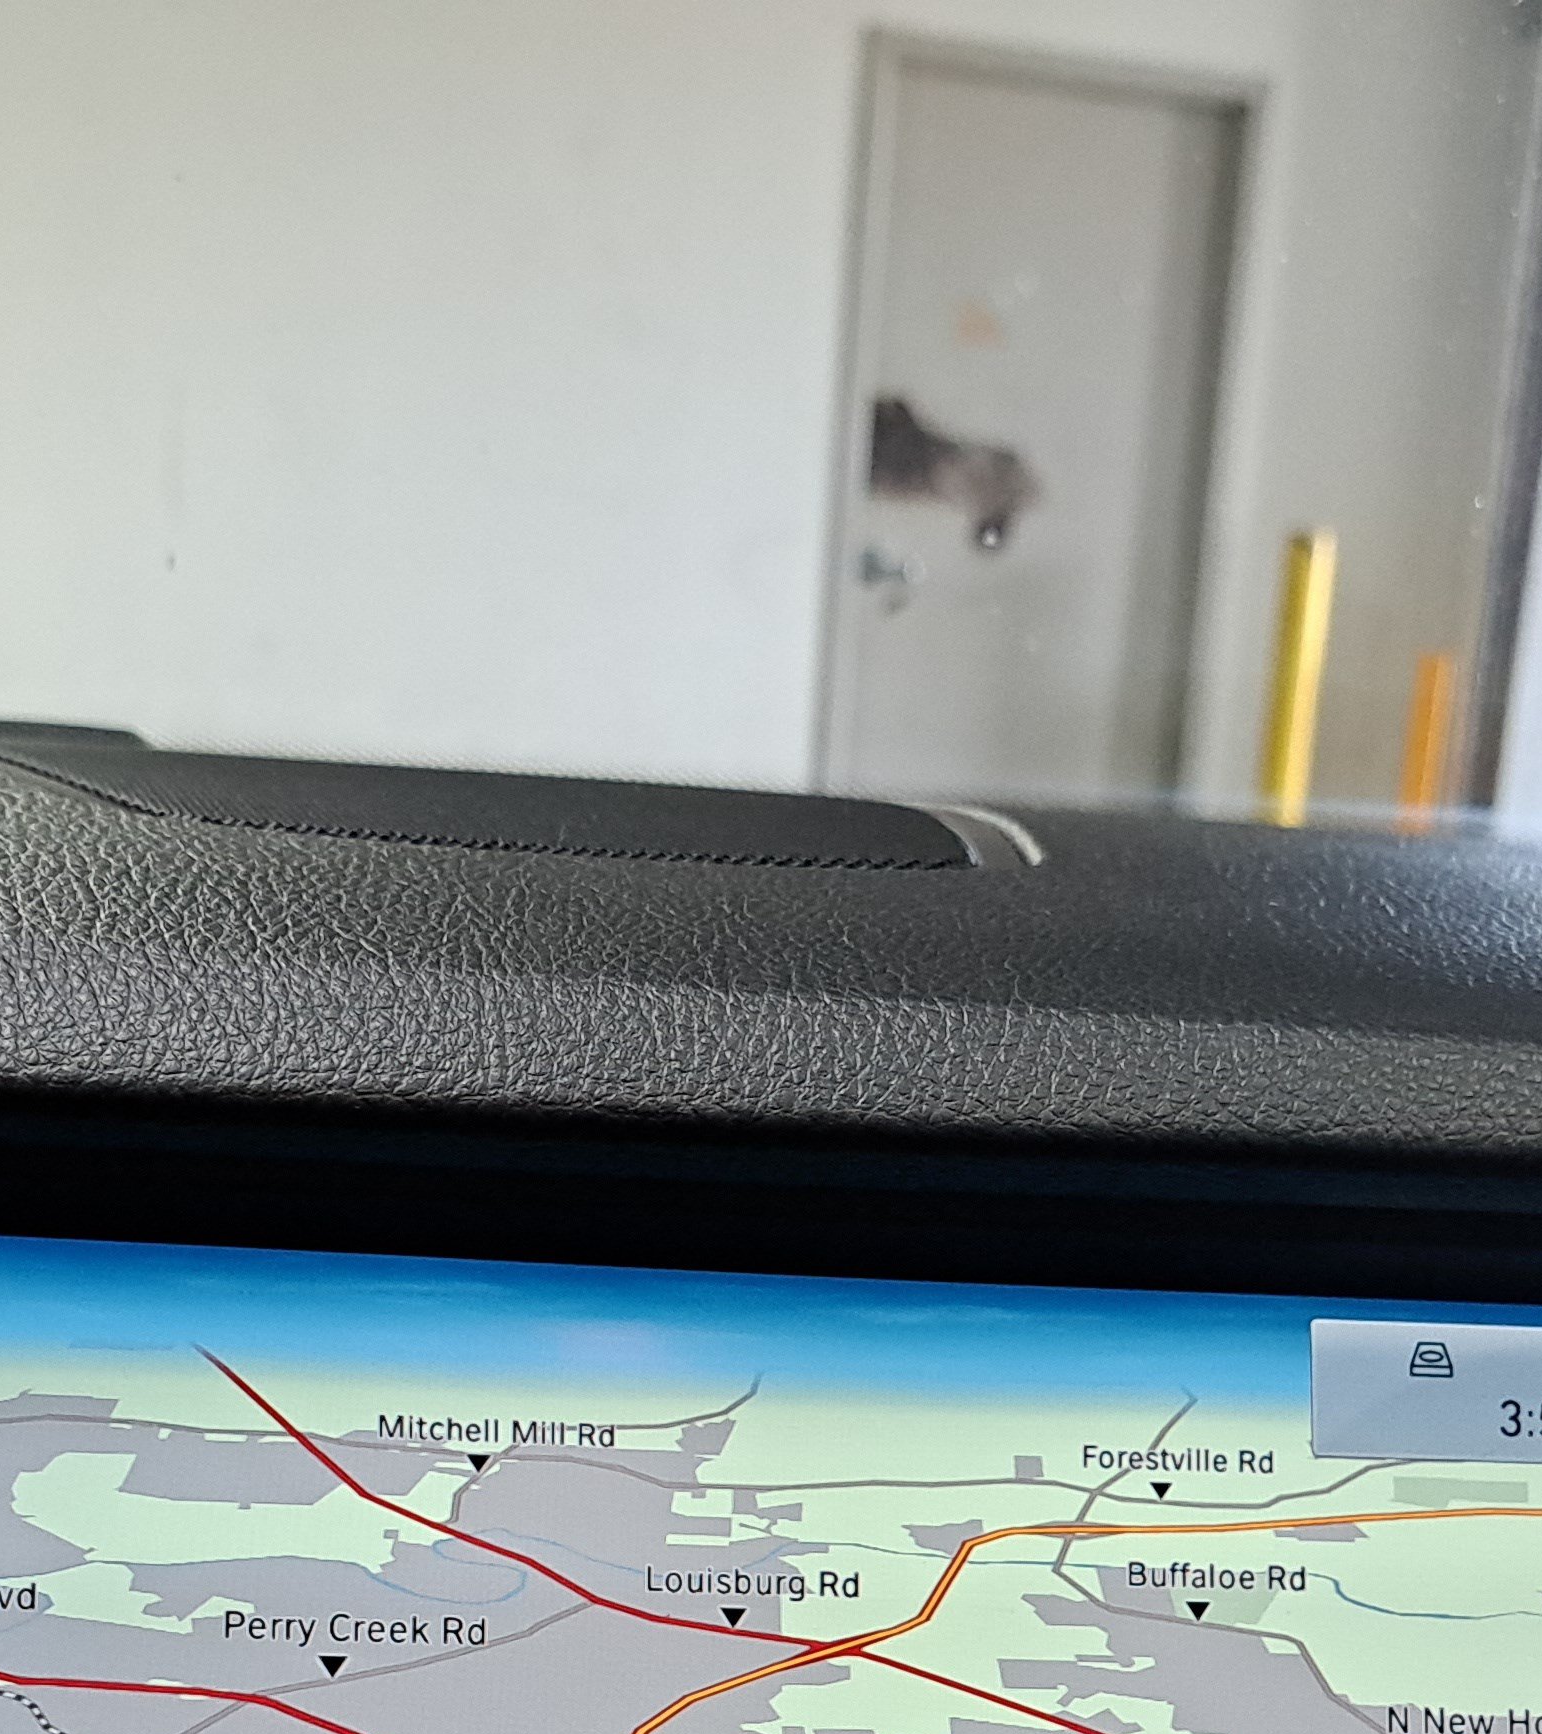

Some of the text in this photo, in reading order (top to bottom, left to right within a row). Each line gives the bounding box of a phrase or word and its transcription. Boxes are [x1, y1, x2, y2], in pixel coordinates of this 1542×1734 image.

[379, 1414, 615, 1448] Mitchell Mill Rd
[1081, 1445, 1273, 1474] Forestville Rd
[647, 1566, 859, 1601] Louisburg Rd
[1128, 1561, 1306, 1592] Buffaloe Rd
[225, 1610, 485, 1648] Perry Creek Rd
[1388, 1706, 1408, 1734] N
